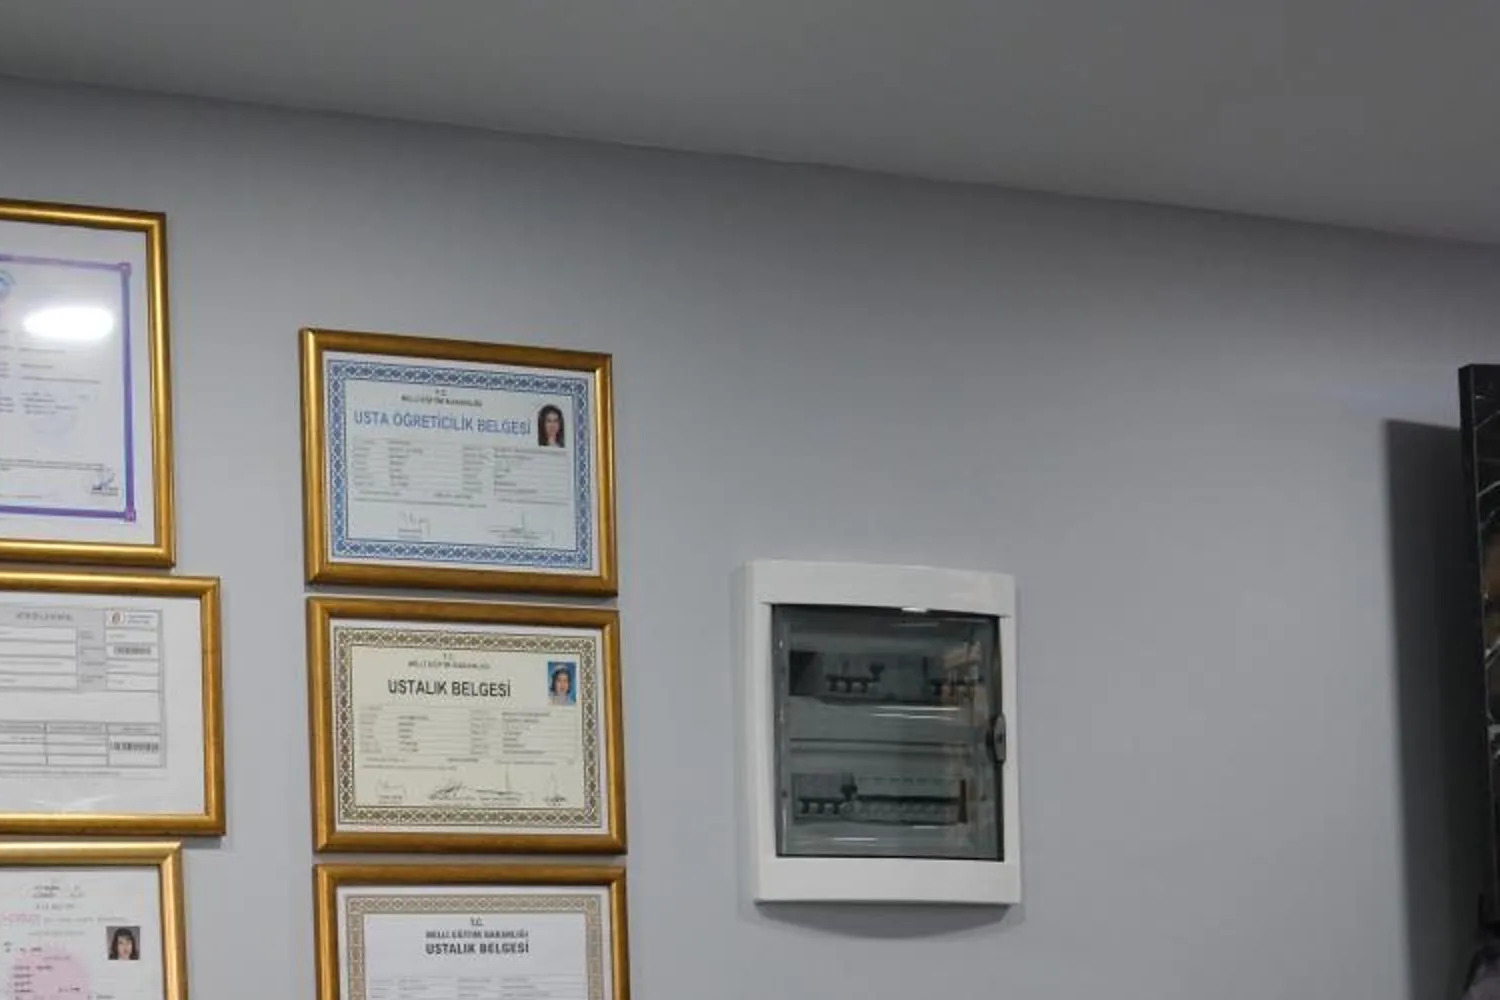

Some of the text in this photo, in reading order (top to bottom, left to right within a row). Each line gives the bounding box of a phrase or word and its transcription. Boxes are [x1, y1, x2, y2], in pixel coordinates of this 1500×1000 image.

[353, 411, 392, 426] USTA
[387, 679, 511, 697] USTALIK BELGESİ
[425, 943, 476, 955] USTALIK
